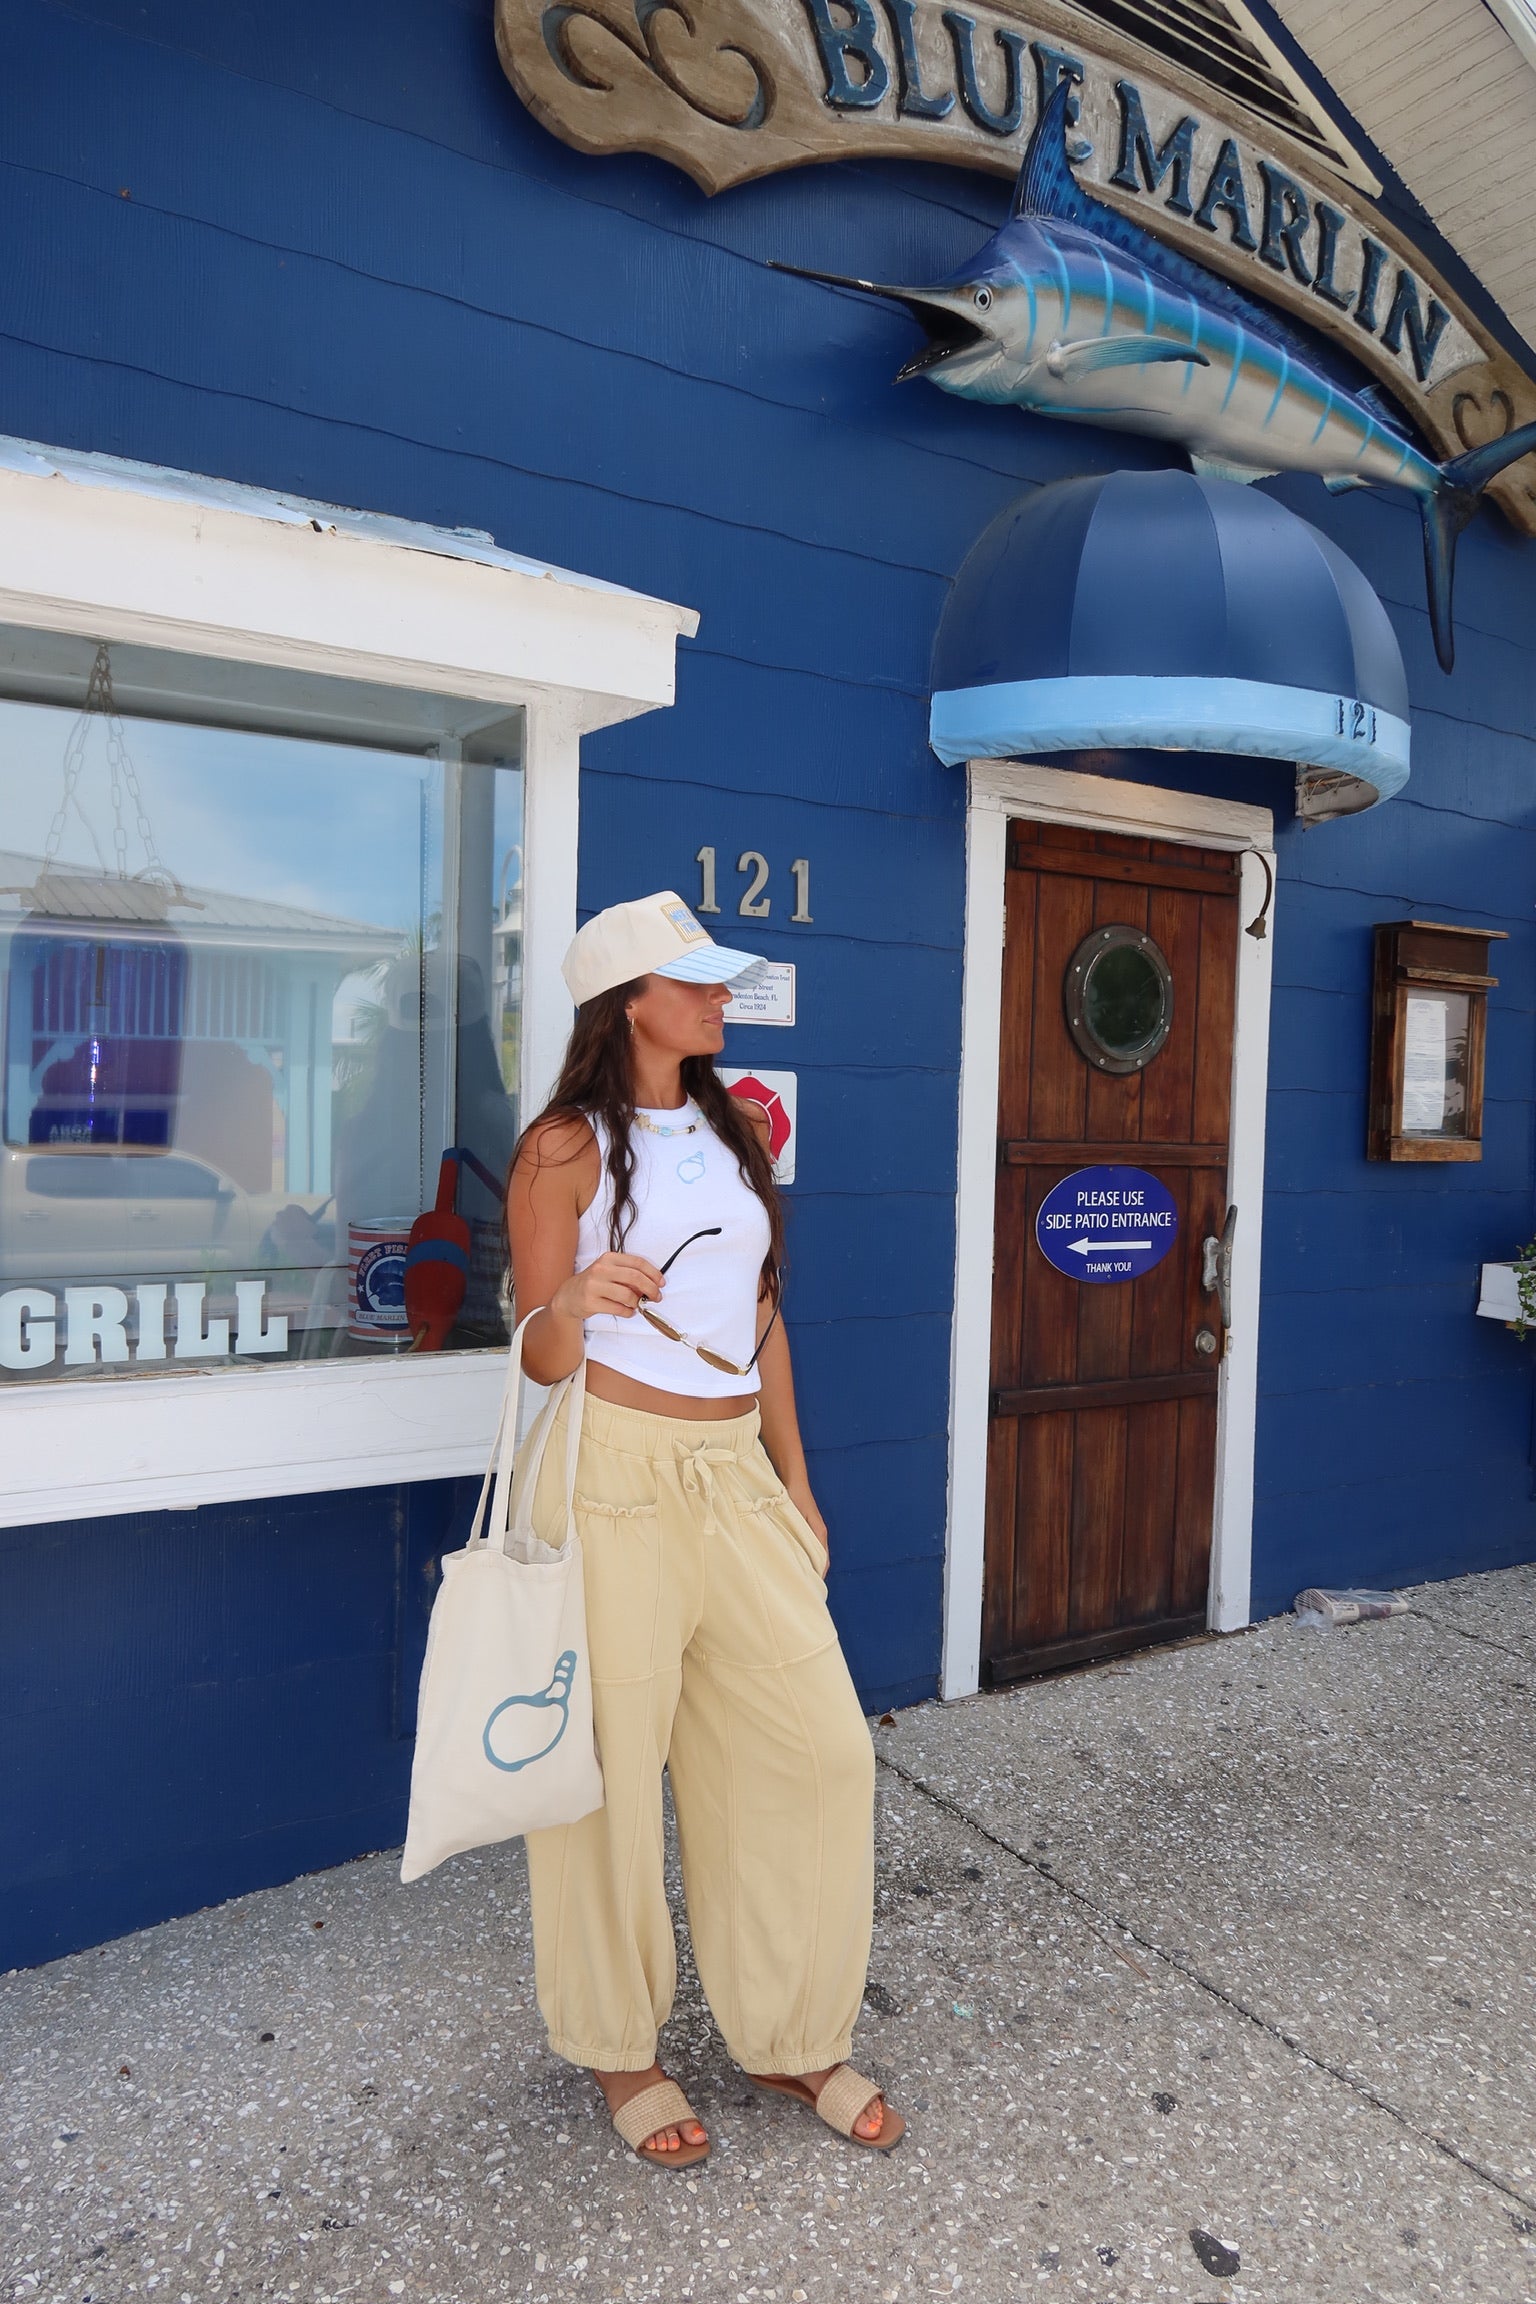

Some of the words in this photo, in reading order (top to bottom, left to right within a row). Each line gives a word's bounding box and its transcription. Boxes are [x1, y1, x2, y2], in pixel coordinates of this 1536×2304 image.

[806, 0, 1094, 163] BLUE
[1110, 79, 1451, 382] MARLIN
[1336, 699, 1377, 745] 121
[696, 846, 814, 923] 121
[1046, 1214, 1072, 1229] SIDE
[1075, 1213, 1109, 1228] PATIO
[1112, 1212, 1172, 1228] ENTRANCE
[1077, 1192, 1120, 1206] PLEASE
[1123, 1191, 1144, 1206] USE
[1086, 1263, 1112, 1273] THANK
[1114, 1262, 1132, 1272] YOU!
[0, 1280, 288, 1370] GRILL
